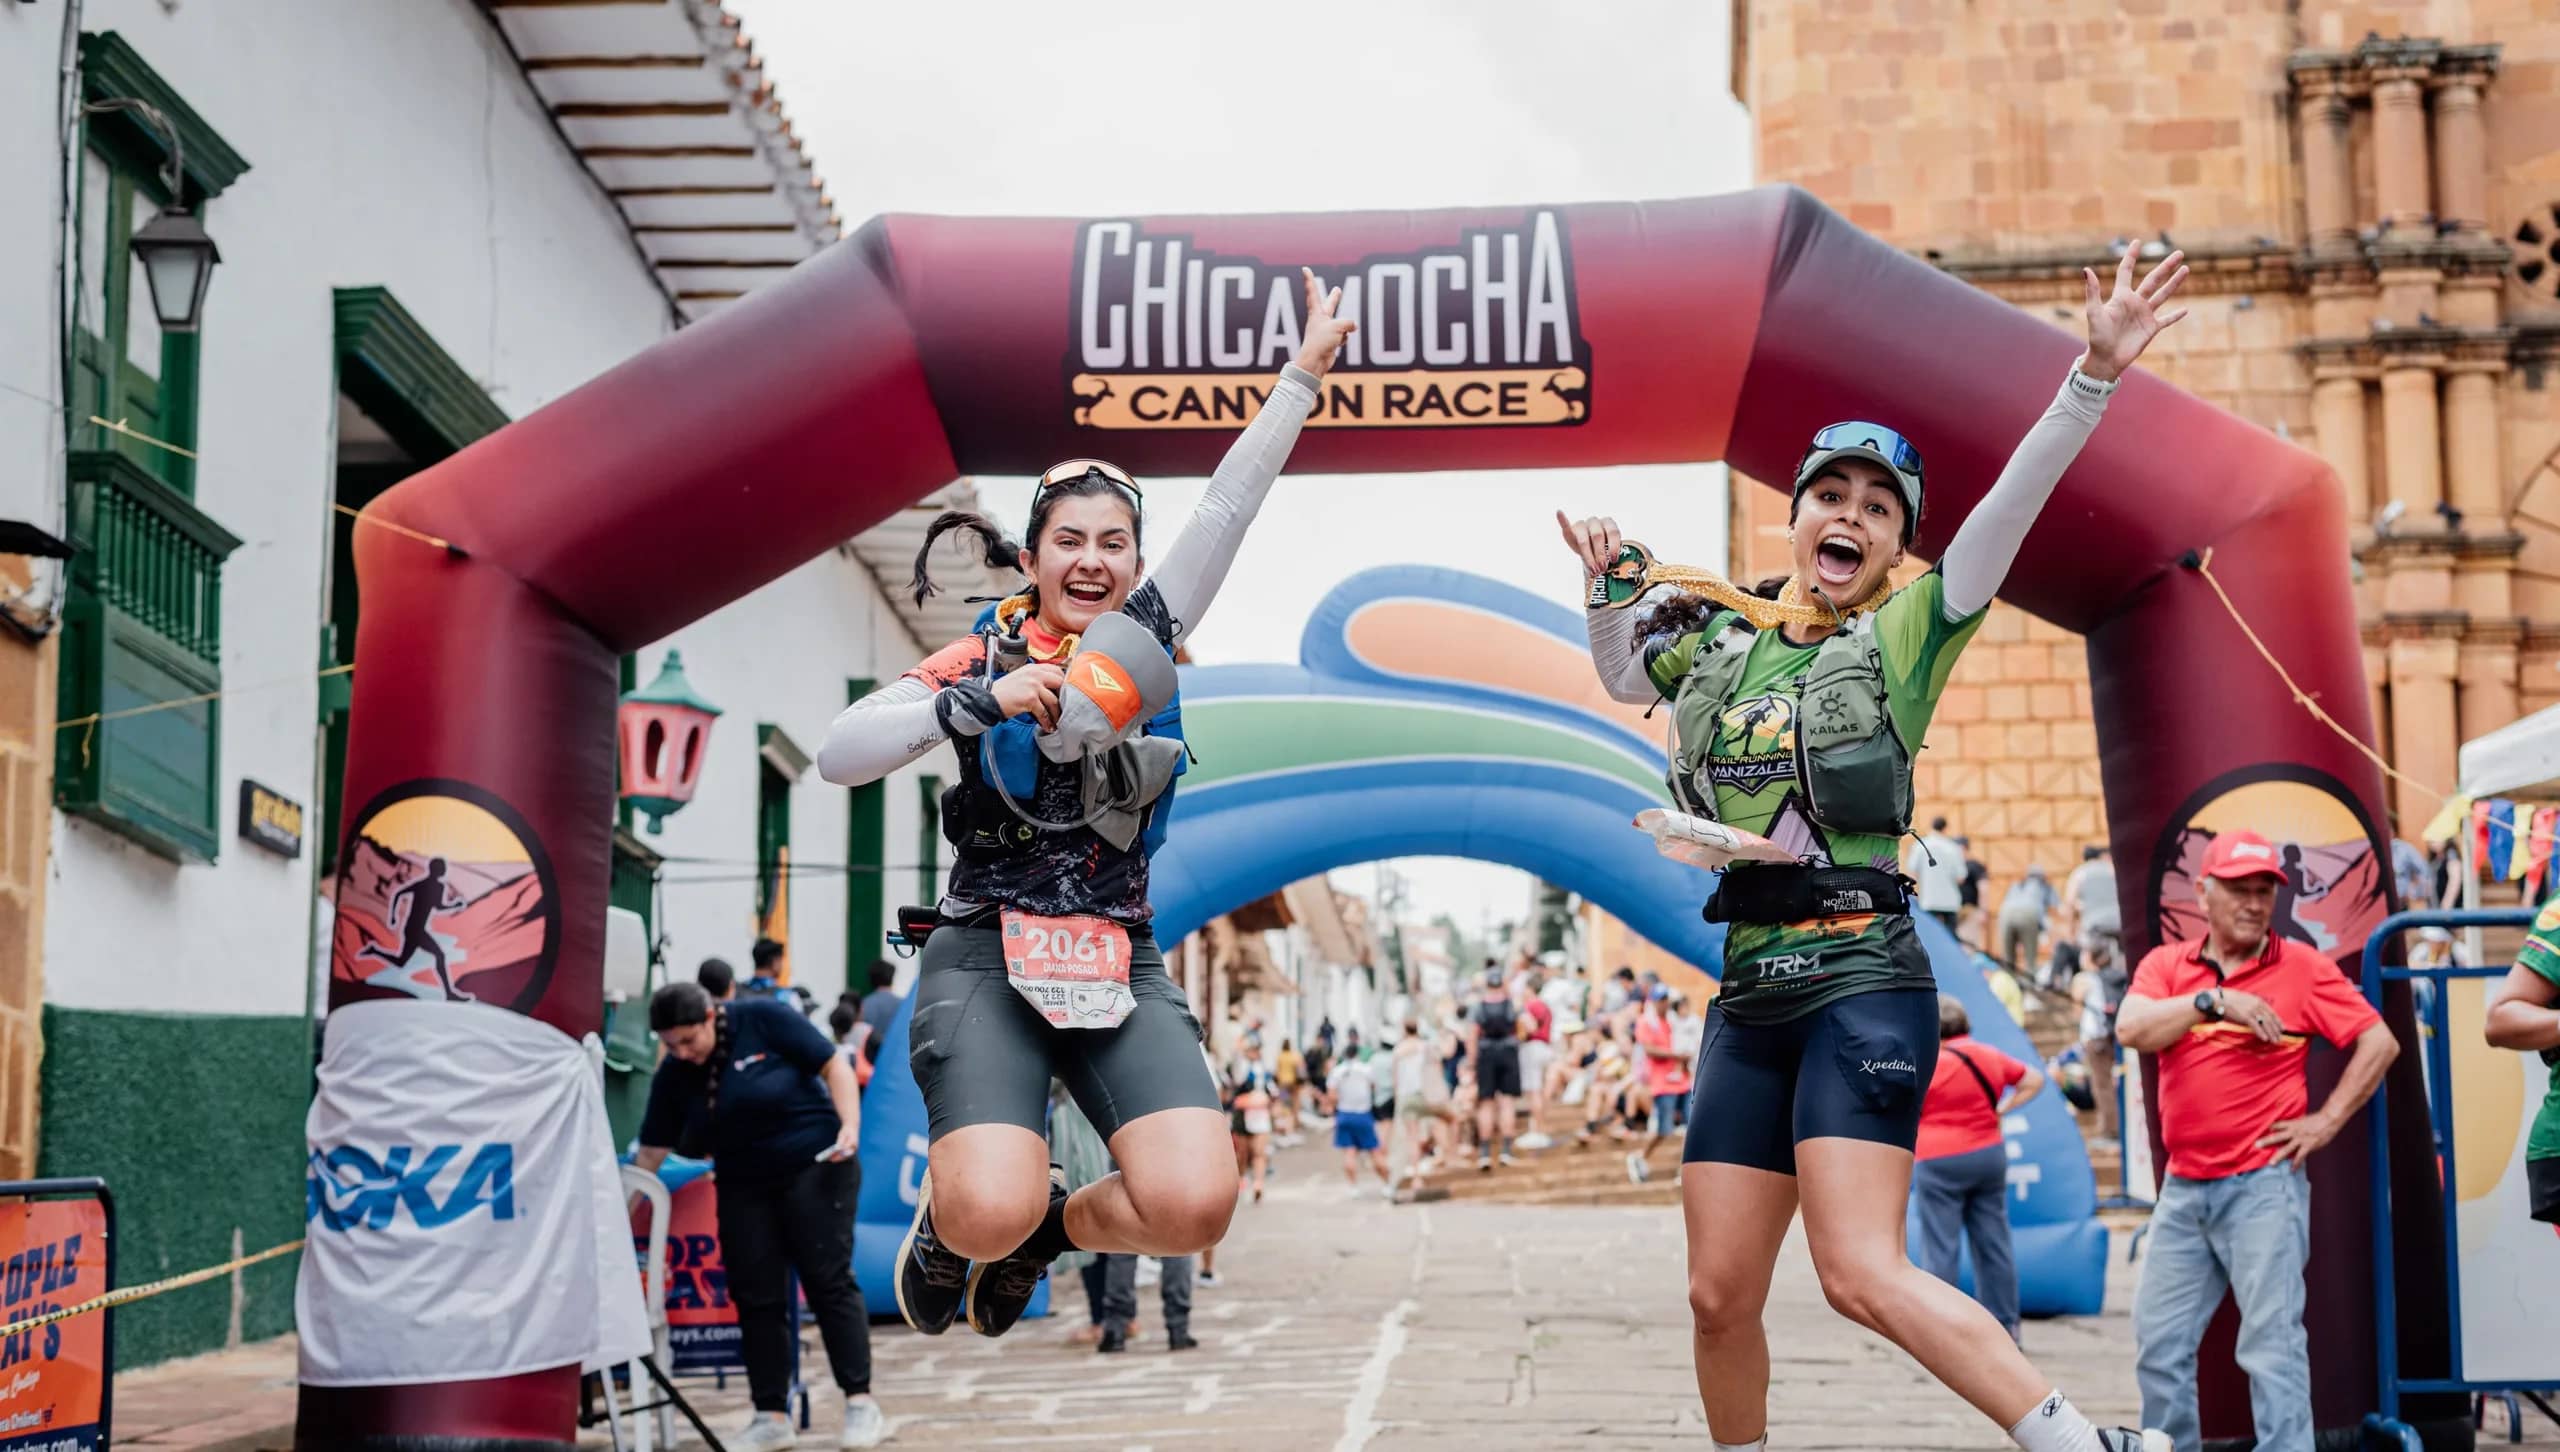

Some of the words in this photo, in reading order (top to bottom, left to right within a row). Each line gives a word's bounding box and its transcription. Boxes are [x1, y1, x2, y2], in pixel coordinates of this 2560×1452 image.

[1382, 381, 1529, 419] RACE
[1809, 722, 1860, 737] KAILAS
[1709, 755, 1737, 765] TRAIL
[1837, 890, 1857, 899] THE
[1823, 898, 1857, 908] NORTH
[1834, 904, 1857, 912] FACE
[1024, 926, 1117, 963] 2061
[1043, 961, 1067, 974] DIANA
[1067, 963, 1099, 976] POSADA
[1756, 951, 1822, 978] TRM
[0, 1234, 82, 1310] OPLE
